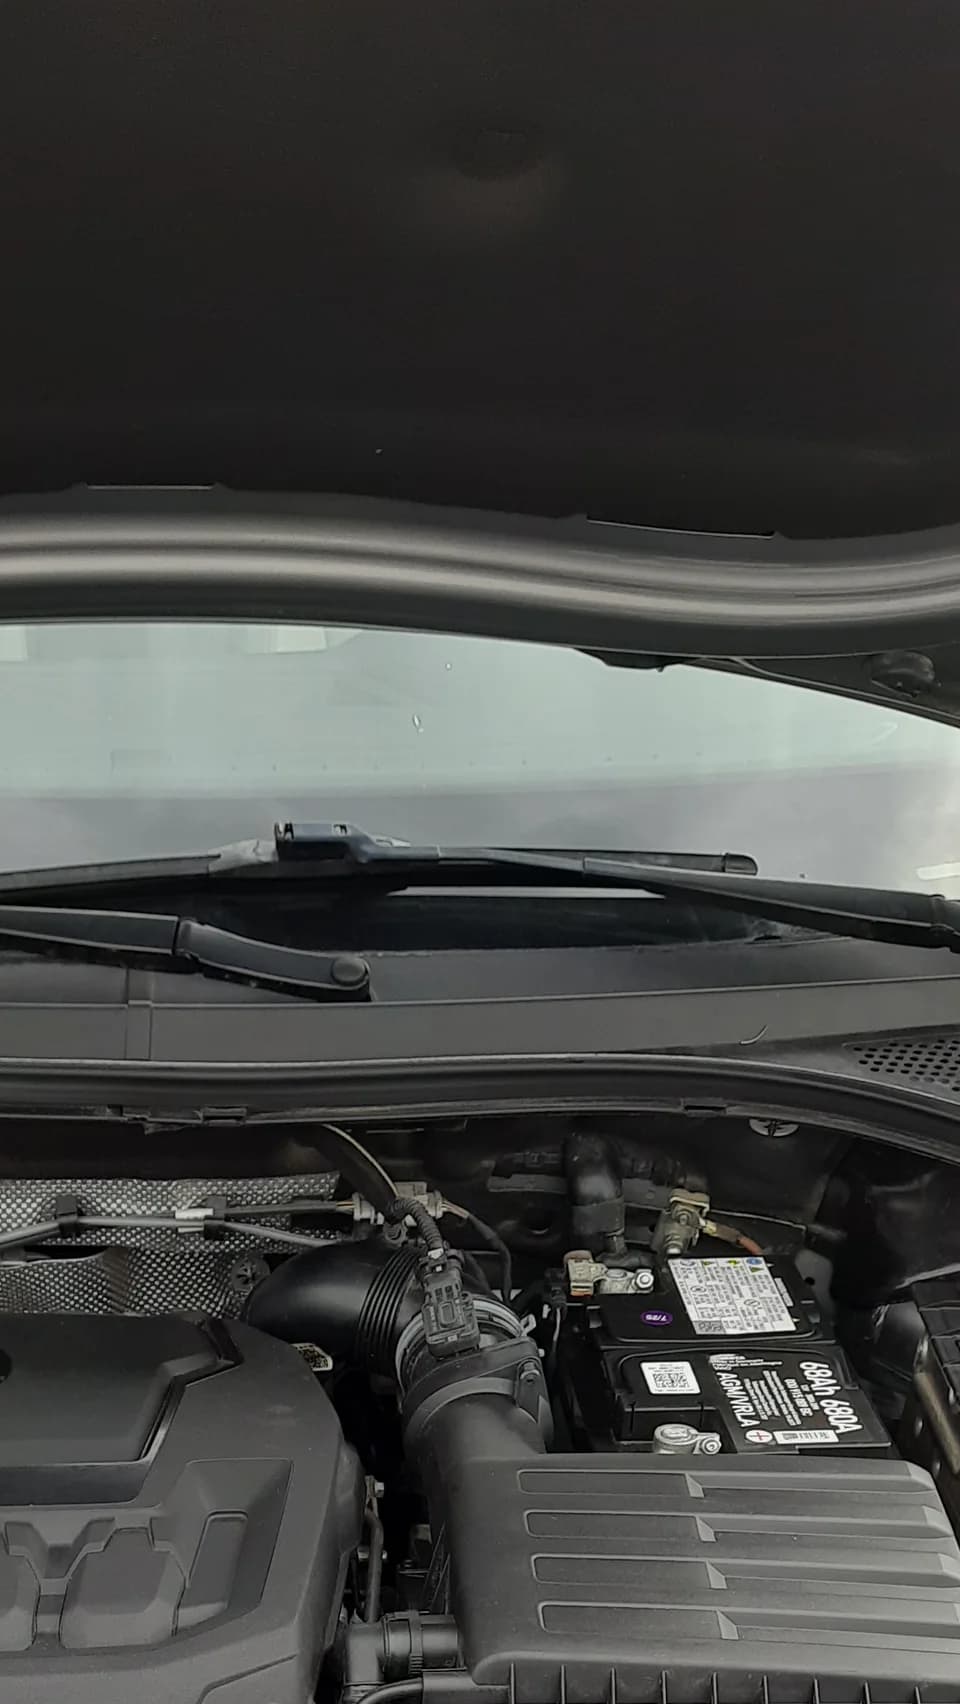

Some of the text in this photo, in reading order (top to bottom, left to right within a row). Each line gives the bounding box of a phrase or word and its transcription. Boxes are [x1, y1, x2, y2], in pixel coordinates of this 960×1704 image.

[716, 1372, 760, 1427] AGM/VRLA
[800, 1362, 862, 1433] 68Ah 680A
